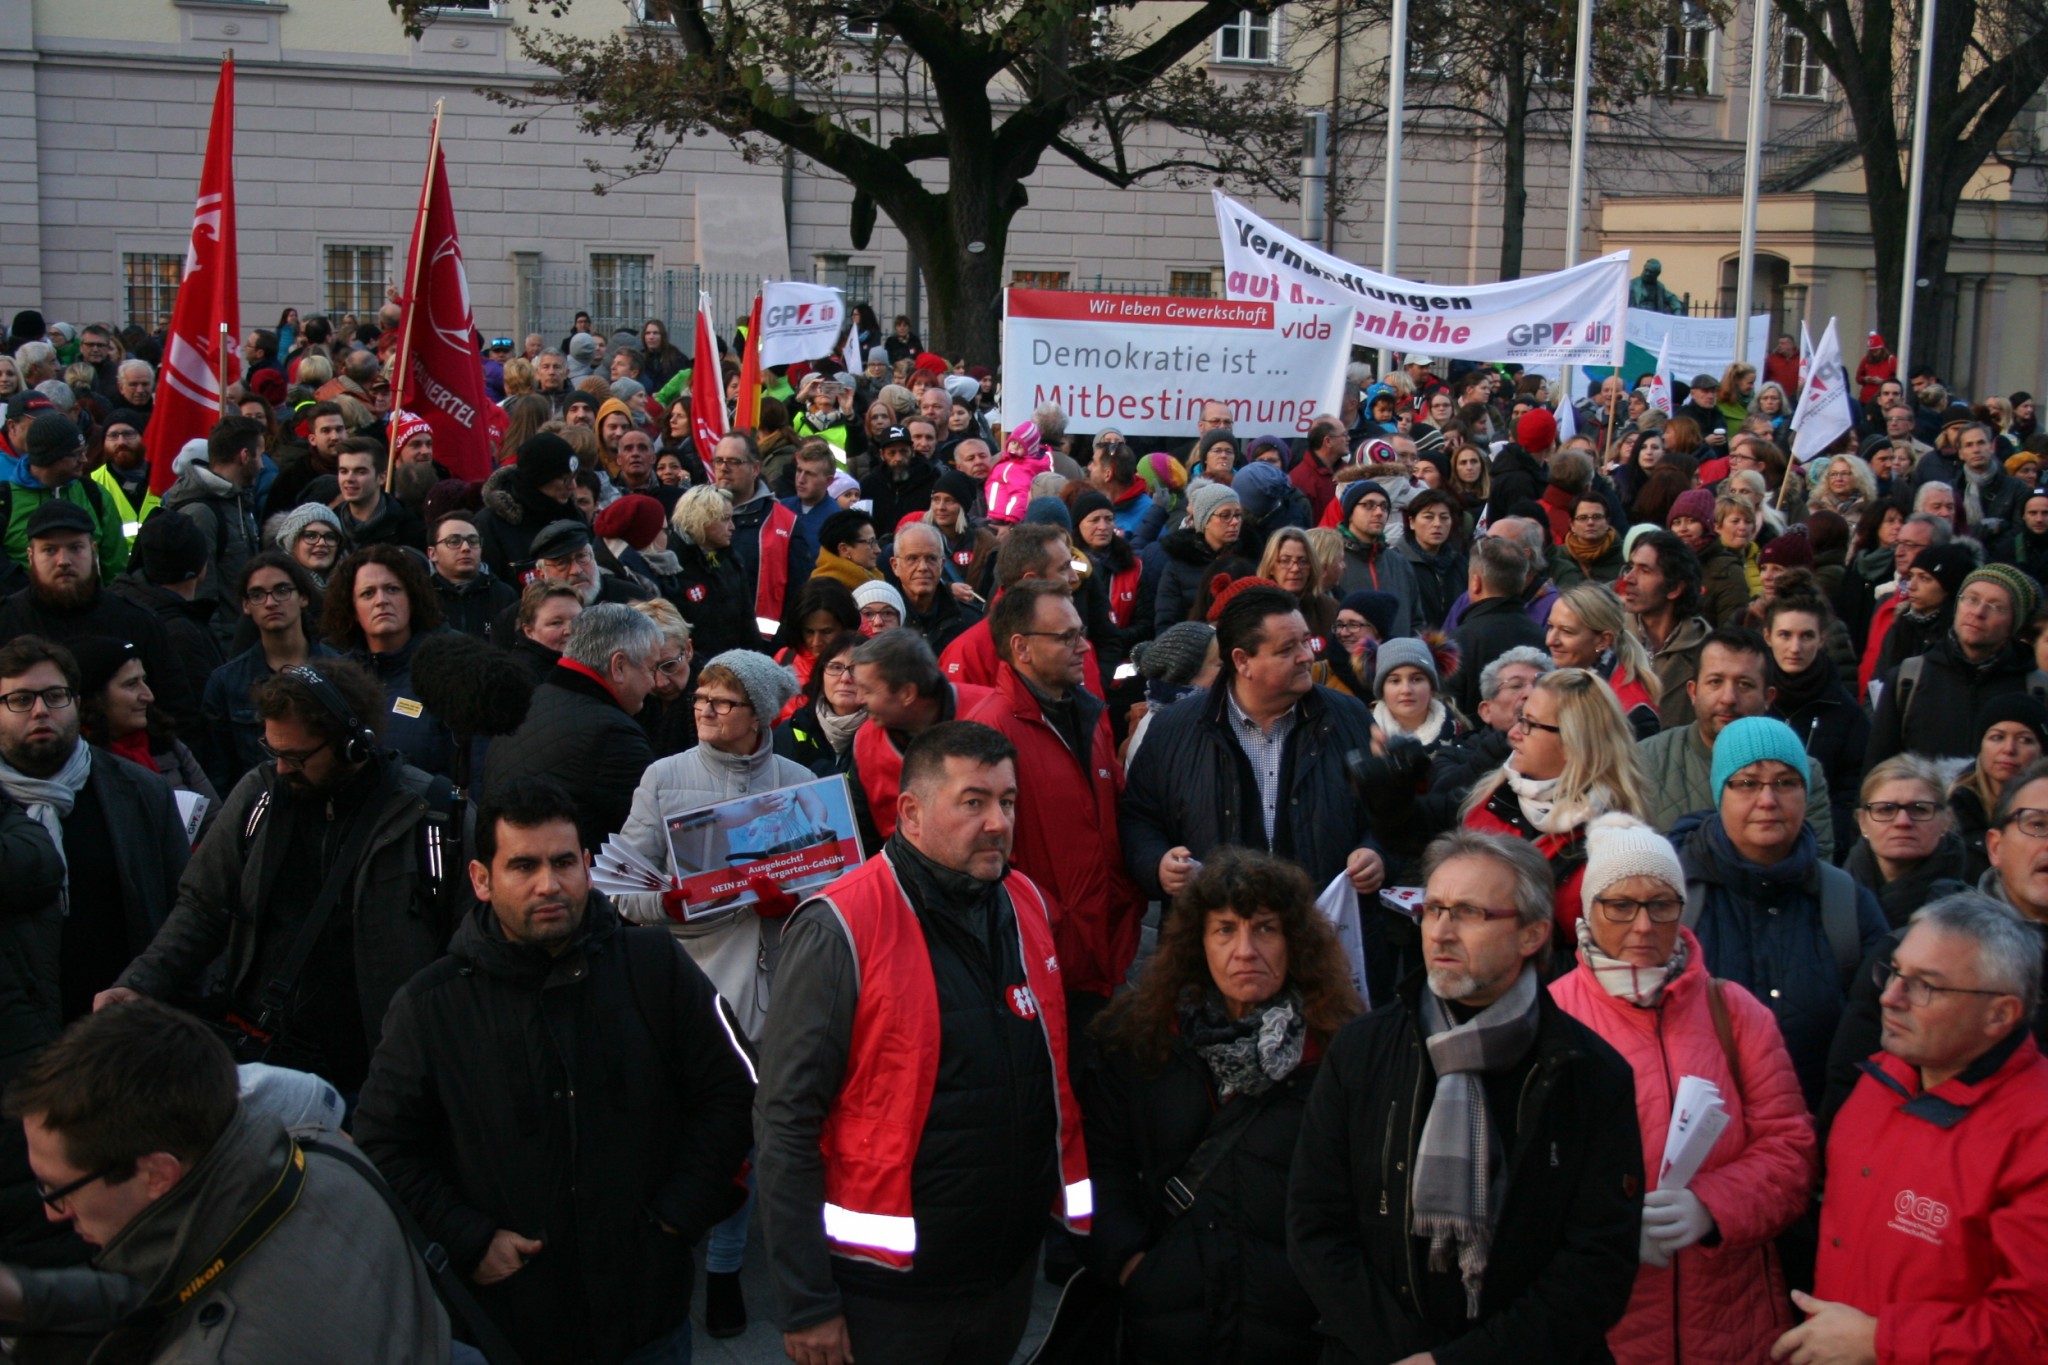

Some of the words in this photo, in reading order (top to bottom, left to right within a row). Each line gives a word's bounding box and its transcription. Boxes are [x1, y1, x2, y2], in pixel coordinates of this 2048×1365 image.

[1089, 299, 1116, 315] Wir
[1120, 301, 1160, 317] leben
[1165, 303, 1268, 326] Gewerkschaft
[1227, 271, 1279, 301] auf
[1290, 282, 1472, 345] Aenhöhe
[1281, 314, 1331, 340] vida
[1507, 321, 1573, 347] GPA
[1585, 320, 1612, 346] djp
[1032, 339, 1210, 372] Demokratie
[1222, 347, 1257, 375] ist
[711, 882, 735, 895] NEIN
[736, 879, 748, 889] zu
[748, 854, 846, 882] dergarten-Gebühr
[748, 853, 804, 875] Ausgekocht!
[179, 1258, 225, 1303] Nikon
